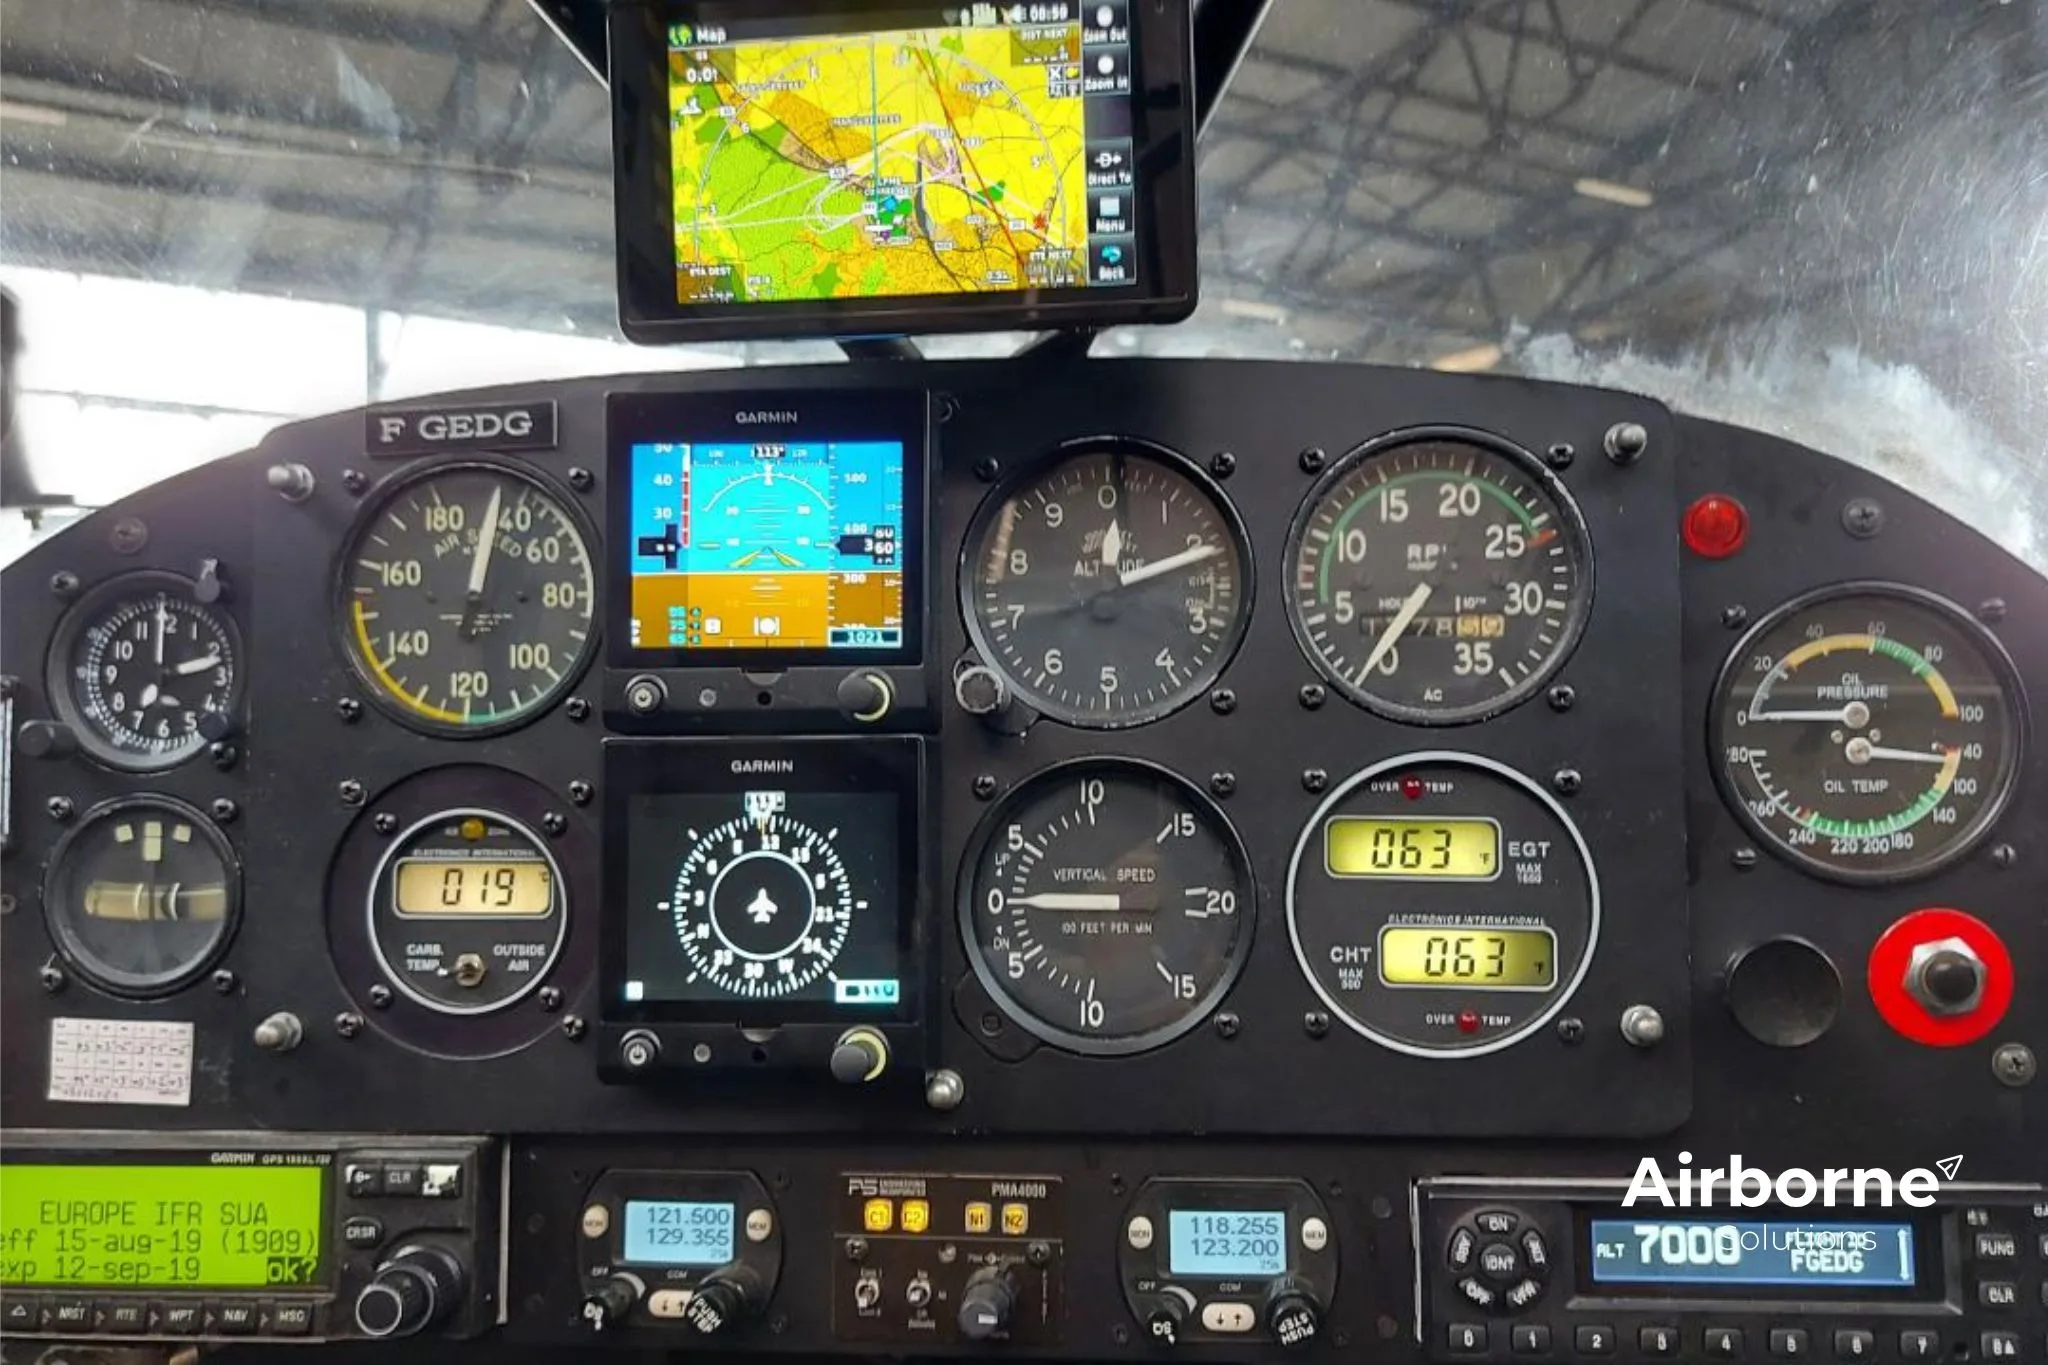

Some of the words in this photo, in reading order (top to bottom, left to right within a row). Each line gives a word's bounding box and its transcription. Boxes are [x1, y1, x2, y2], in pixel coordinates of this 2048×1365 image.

[696, 26, 727, 43] Map
[1084, 79, 1115, 91] Zoom
[1088, 173, 1117, 186] Direct
[1119, 171, 1132, 184] To
[1096, 218, 1126, 232] Menu
[379, 416, 406, 443] F
[418, 410, 533, 441] GEDG
[735, 411, 798, 424] GARMIN
[653, 473, 674, 487] 40
[1097, 484, 1117, 509] 0
[1380, 489, 1409, 523] 15
[1439, 483, 1481, 517] 20
[425, 505, 465, 532] 180
[498, 506, 532, 533] 40
[652, 506, 674, 520] 30
[1044, 503, 1063, 528] 9
[1162, 500, 1168, 525] 1
[526, 536, 560, 564] 60
[1337, 530, 1367, 562] 10
[1485, 525, 1525, 560] 25
[1010, 549, 1029, 576] 8
[380, 560, 422, 587] 160
[542, 582, 575, 609] 80
[1503, 581, 1543, 616] 30
[1007, 604, 1026, 631] 7
[1335, 591, 1354, 624] 5
[136, 620, 148, 641] 11
[191, 621, 198, 641] 1
[1806, 624, 1824, 639] 40
[114, 640, 134, 662] 10
[388, 630, 430, 656] 140
[1925, 645, 1943, 661] 80
[508, 642, 550, 670] 100
[1044, 649, 1063, 675] 6
[1155, 647, 1175, 673] 4
[1376, 646, 1399, 675] 0
[1454, 641, 1494, 676] 35
[1754, 655, 1772, 671] 20
[105, 664, 118, 685] 9
[214, 666, 228, 687] 3
[450, 671, 489, 698] 120
[1100, 666, 1119, 693] 5
[1841, 672, 1862, 686] OIL
[112, 691, 126, 712] 8
[1424, 688, 1443, 701] AC
[1817, 685, 1889, 698] PRESSURE
[203, 692, 217, 712] 4
[132, 710, 145, 731] 7
[184, 710, 198, 732] 5
[1737, 710, 1747, 725] 0
[1961, 705, 1984, 722] 100
[158, 718, 171, 739] 6
[1963, 743, 1982, 759] 40
[731, 759, 794, 773] GARMIN
[1080, 779, 1105, 805] 10
[1371, 782, 1399, 792] OVER
[1425, 783, 1454, 793] TEMP
[1824, 780, 1845, 793] OIL
[1852, 780, 1889, 793] TEMP
[1954, 778, 1977, 794] 100
[1174, 813, 1196, 837] 15
[1933, 807, 1956, 824] 140
[1008, 825, 1024, 850] 5
[1788, 828, 1816, 845] 240
[1831, 838, 1858, 855] 220
[1862, 837, 1889, 854] 200
[1890, 832, 1914, 849] 180
[1371, 828, 1452, 869] 063
[1508, 841, 1551, 858] EGT
[1053, 867, 1106, 881] VERTICAL
[1117, 867, 1156, 882] SPEED
[1516, 863, 1541, 872] MAX
[441, 868, 516, 906] 019
[987, 888, 1004, 915] 0
[1206, 890, 1236, 915] 20
[1080, 922, 1106, 934] FEET
[1111, 922, 1130, 934] PER
[1135, 923, 1152, 935] MIN
[493, 943, 546, 956] OUTSIDE
[1330, 946, 1372, 963] CHT
[1425, 937, 1506, 977] 063
[507, 959, 530, 972] AIR
[1008, 953, 1025, 979] 5
[1339, 968, 1363, 979] MAX
[1174, 975, 1197, 999] 15
[1080, 1001, 1105, 1027] 10
[1426, 1014, 1455, 1025] OVER
[1482, 1015, 1511, 1026] TEMP
[211, 1152, 256, 1165] GARMIN
[992, 1183, 1047, 1198] PMA4000
[40, 1200, 137, 1226] EUROPE
[155, 1201, 203, 1226] IFR
[220, 1202, 269, 1226] SUA
[648, 1207, 730, 1225] 121.500
[1005, 1214, 1023, 1227] N2
[1191, 1216, 1279, 1235] 118.255
[55, 1229, 202, 1255] 15-aug-19
[222, 1229, 318, 1255] (1909)
[648, 1228, 730, 1246] 129.355
[1597, 1243, 1626, 1259] ALT
[1633, 1225, 1742, 1266] 7000
[1191, 1238, 1280, 1257] 123.200
[54, 1256, 201, 1284] 12-sep-19
[1791, 1249, 1865, 1274] FGEDG
[1138, 1281, 1156, 1291] OFF
[1988, 1286, 2015, 1304] CLR
[169, 1309, 195, 1321] WPT
[225, 1309, 248, 1321] NAV
[279, 1310, 304, 1322] MSG
[1282, 1323, 1314, 1346] PUSH
[1463, 1328, 1474, 1348] 0
[1528, 1329, 1537, 1348] 1
[1591, 1334, 1602, 1349] 2
[1721, 1334, 1731, 1351] 4
[1916, 1336, 1927, 1354] 7
